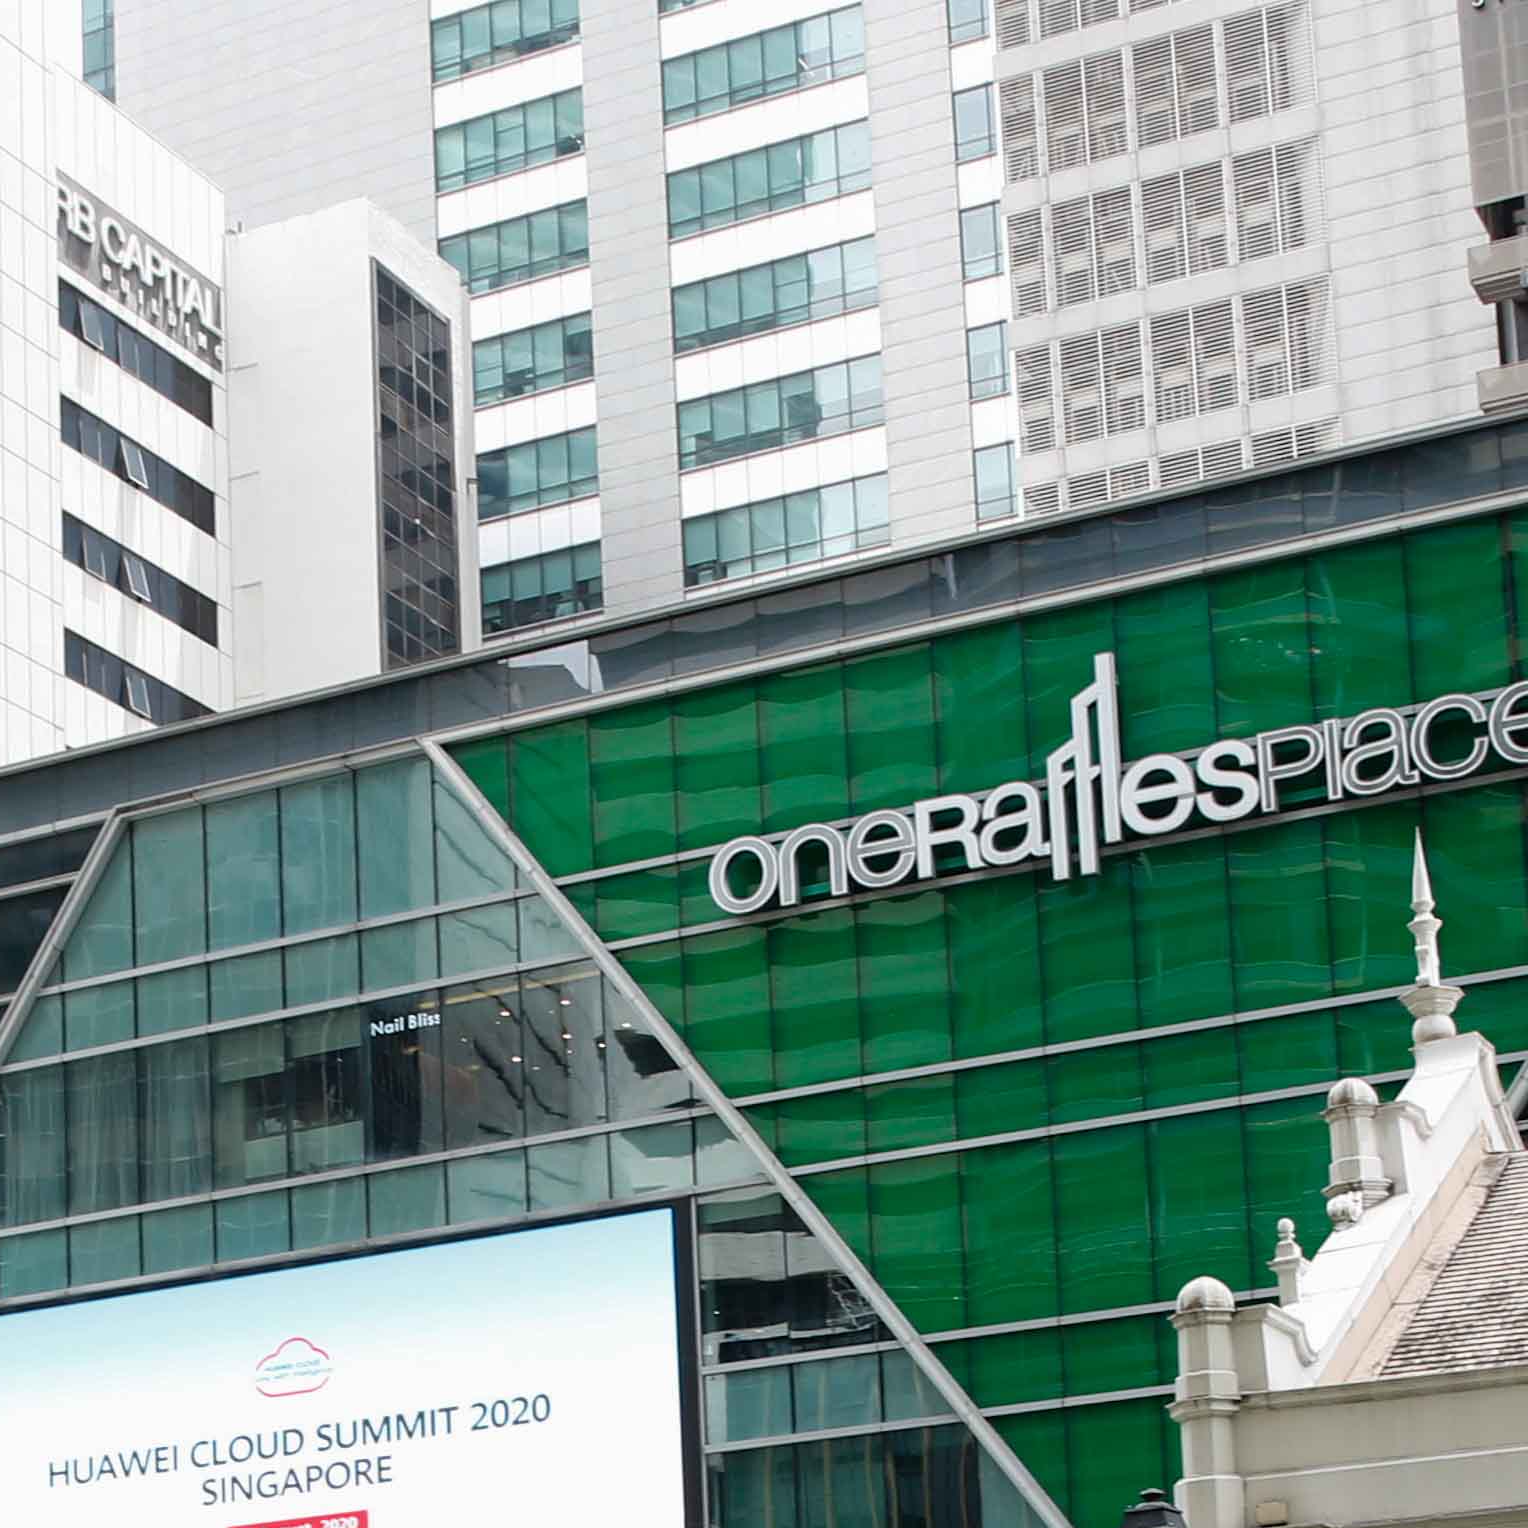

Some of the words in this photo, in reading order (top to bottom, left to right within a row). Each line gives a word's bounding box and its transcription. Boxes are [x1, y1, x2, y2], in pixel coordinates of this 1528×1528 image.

[57, 184, 96, 244] RB
[100, 216, 224, 336] CAPITAL
[370, 1017, 404, 1037] Nail
[408, 1012, 441, 1031] Bliss
[48, 1446, 179, 1488] HUAWEI
[191, 1428, 304, 1469] CLOUD
[317, 1406, 459, 1452] SUMMIT
[471, 1394, 551, 1431] 2020
[201, 1456, 392, 1506] SINGAPORE
